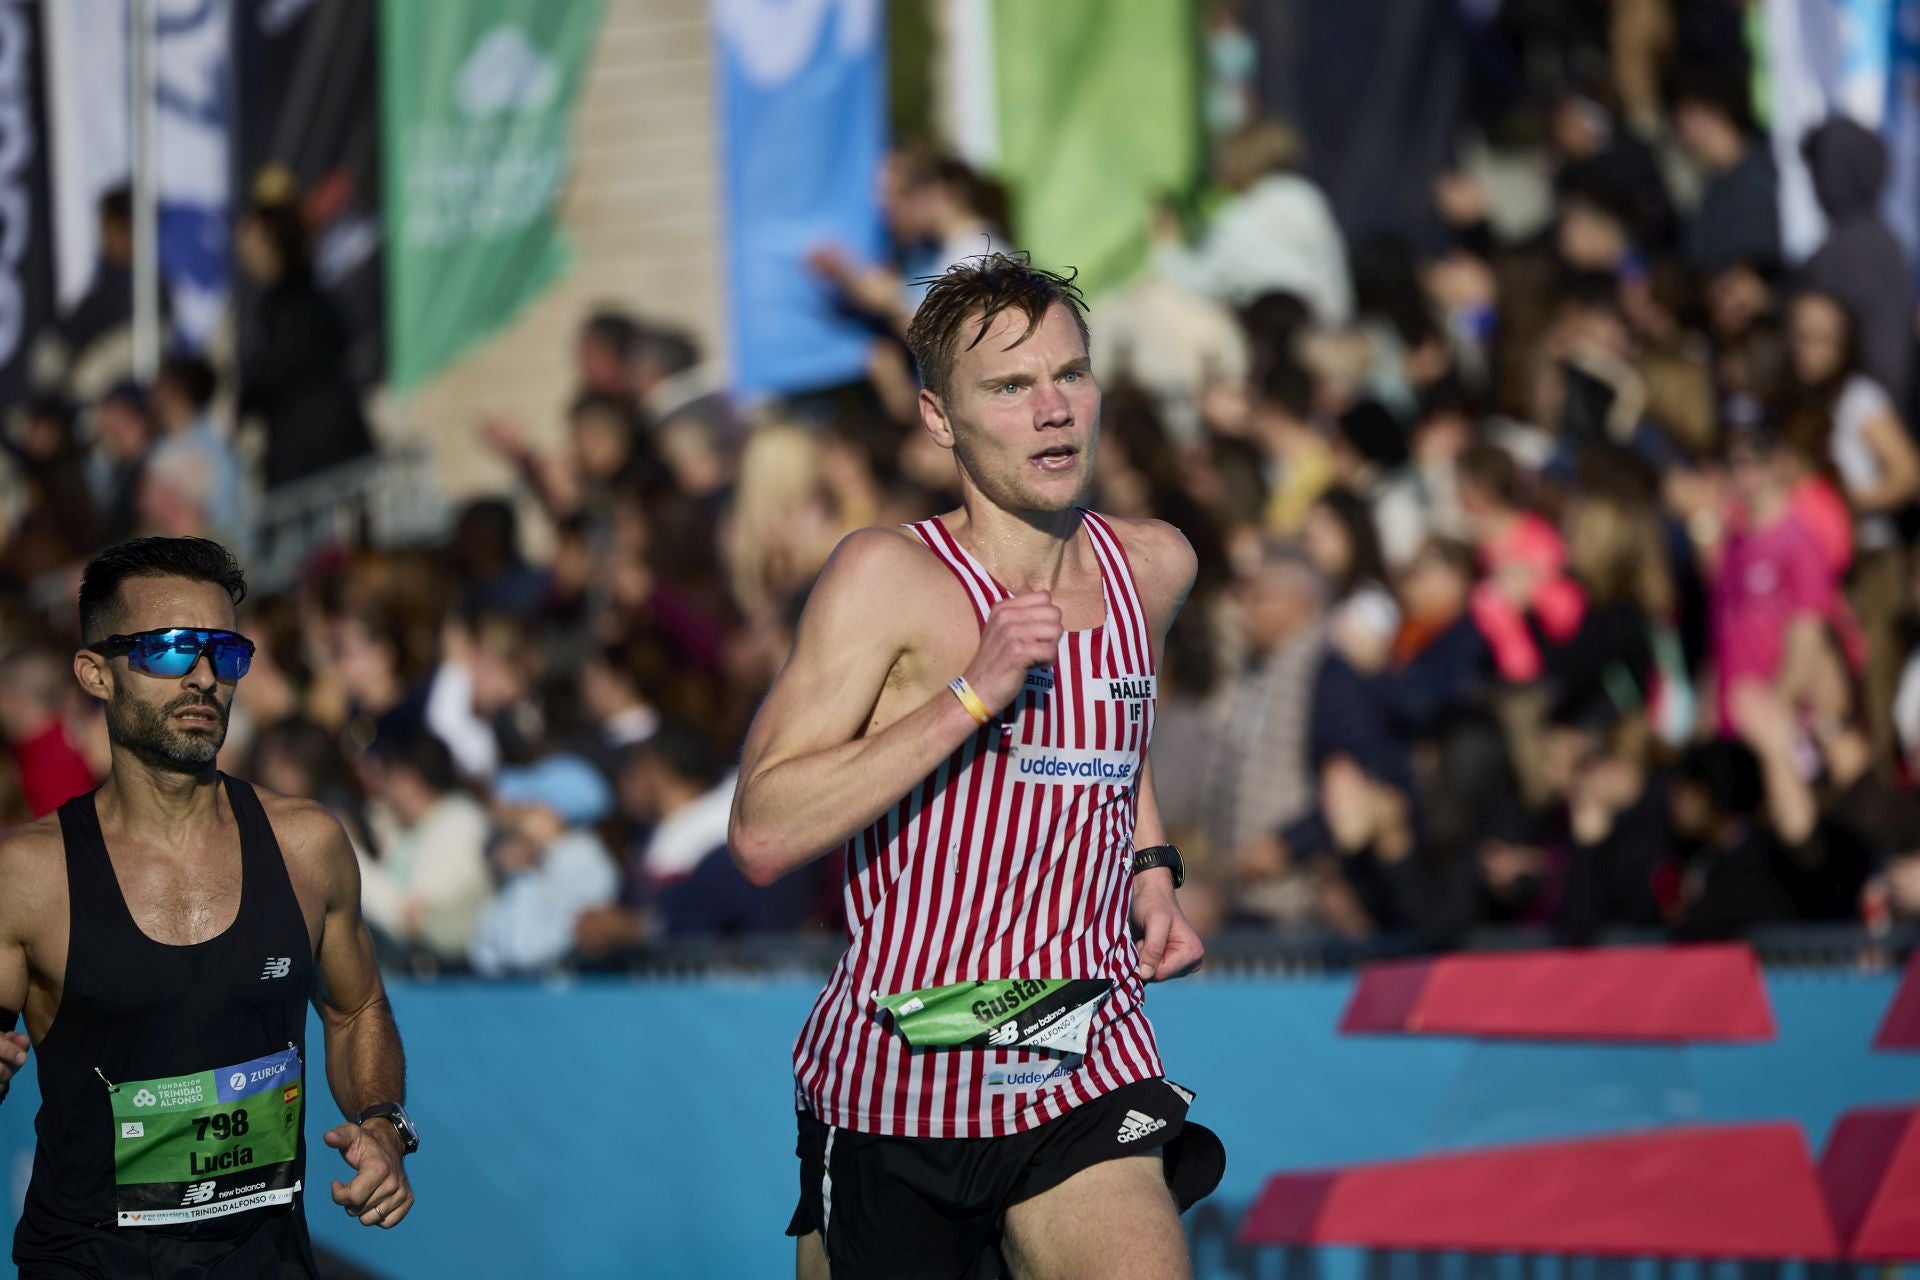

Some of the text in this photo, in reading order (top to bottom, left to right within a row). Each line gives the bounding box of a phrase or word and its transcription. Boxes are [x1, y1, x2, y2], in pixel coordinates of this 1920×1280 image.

[1025, 674, 1053, 689] ame
[1109, 678, 1152, 699] HÄLLE
[1130, 703, 1141, 721] IF
[1020, 755, 1132, 778] uddevalla.se
[1023, 1021, 1040, 1036] new
[1038, 1006, 1066, 1027] balance
[158, 1086, 202, 1099] TRINIDAD
[160, 1094, 203, 1107] ALFONSO
[192, 1109, 249, 1141] 798
[1117, 1119, 1167, 1143] adidas
[190, 1146, 253, 1176] Lucía
[219, 1181, 266, 1199] new balance
[191, 1204, 228, 1218] TRINIDAD
[229, 1195, 267, 1211] ALFONSO
